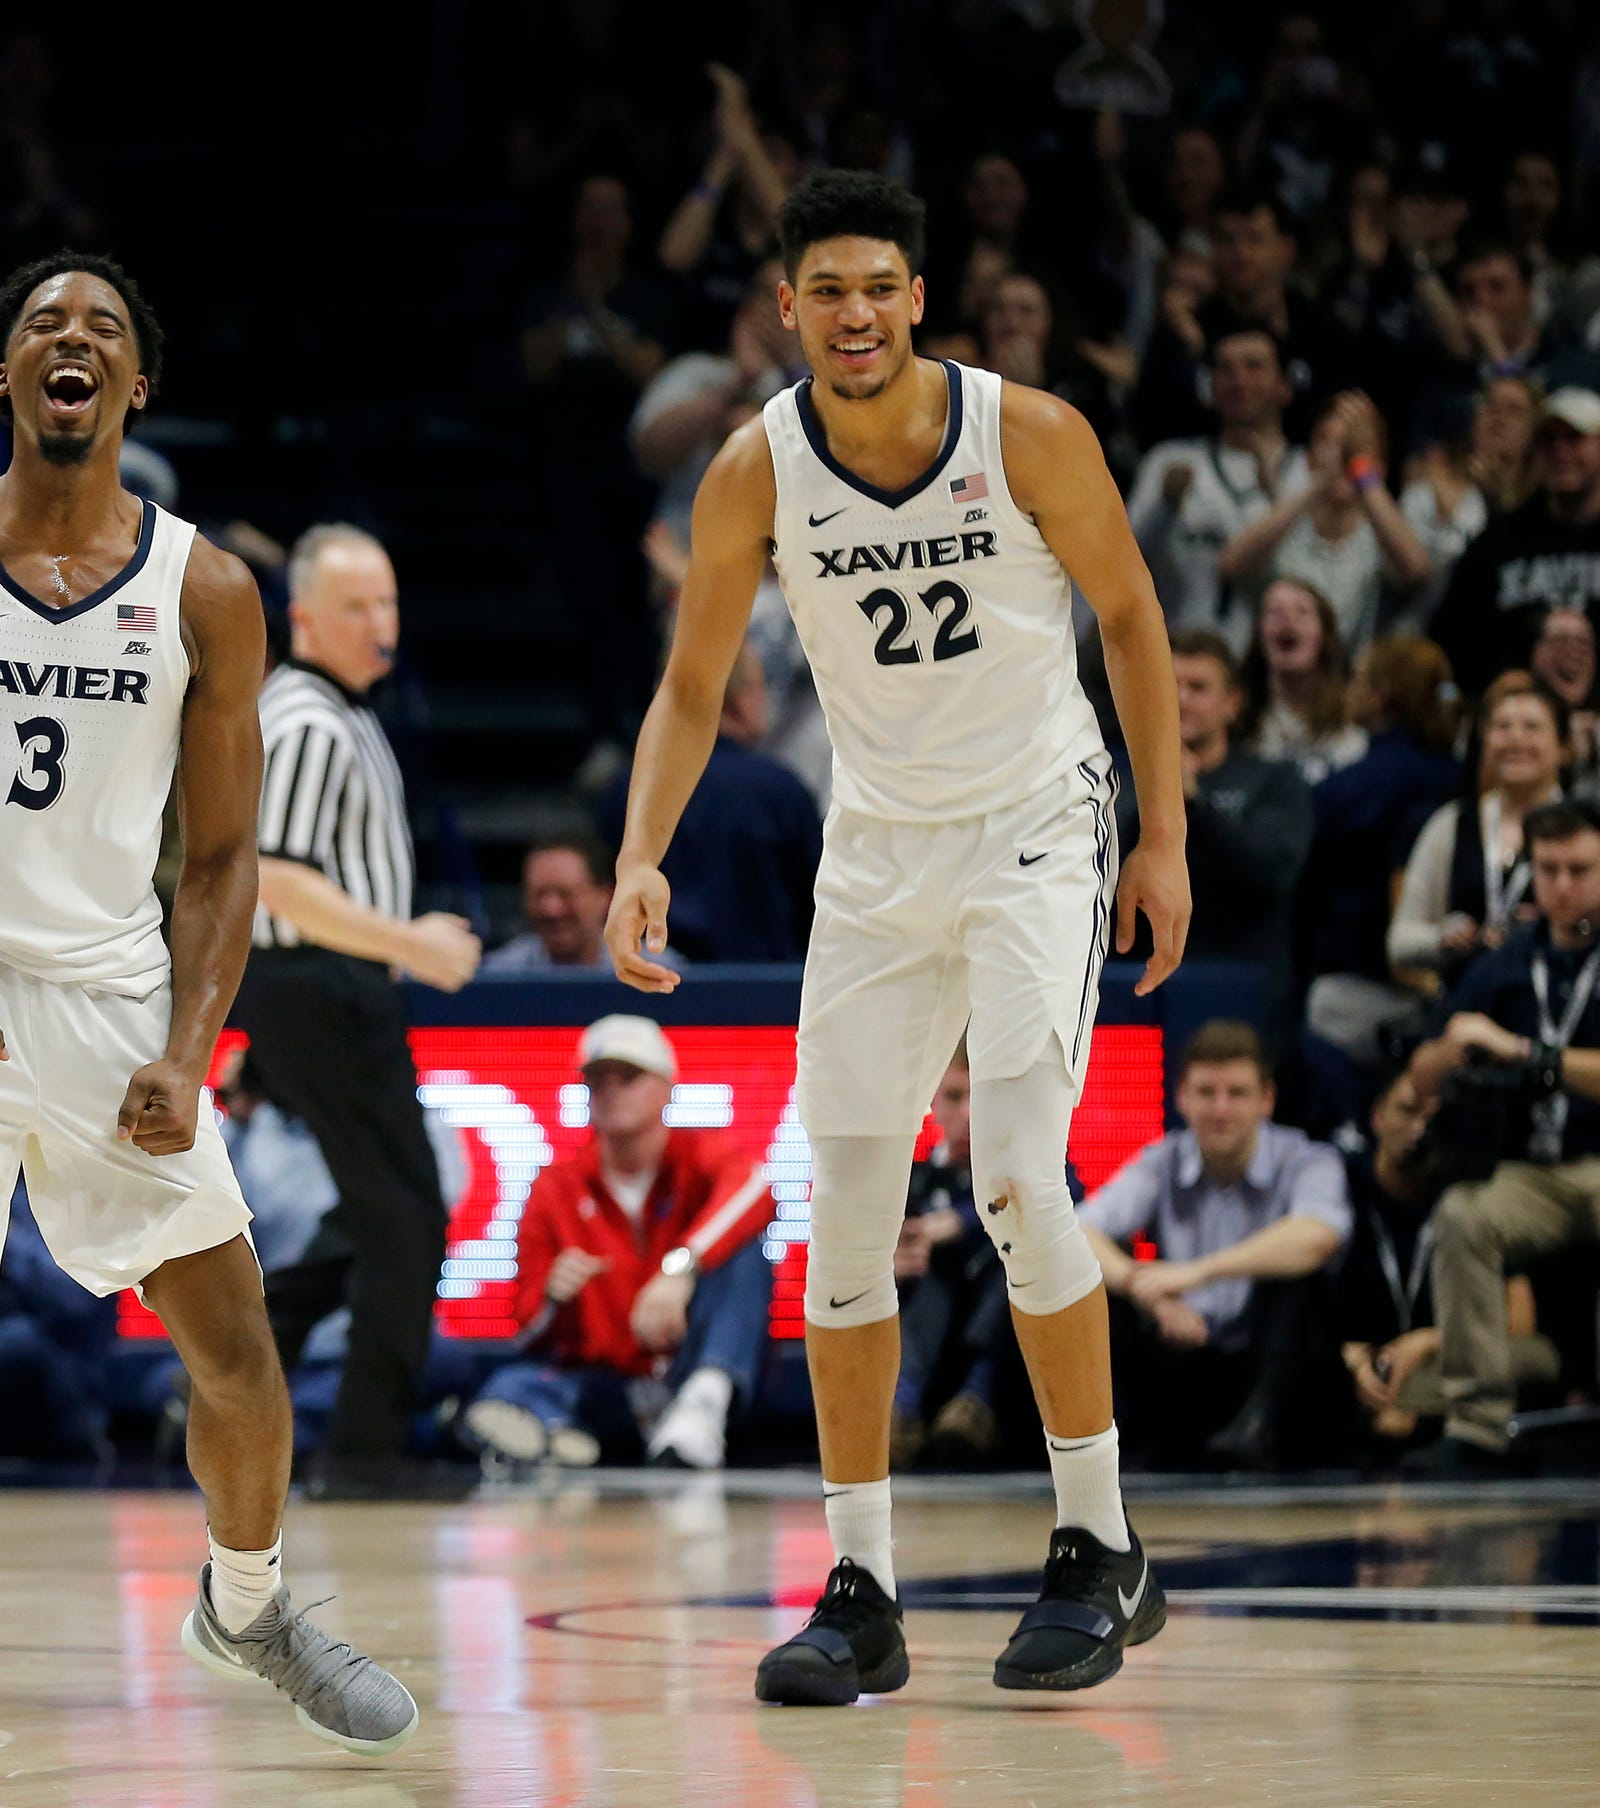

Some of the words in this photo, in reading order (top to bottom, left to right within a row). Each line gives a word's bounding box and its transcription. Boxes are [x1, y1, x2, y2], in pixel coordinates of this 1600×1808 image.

[810, 531, 998, 578] XAVIER
[856, 580, 983, 666] 22
[5, 716, 70, 812] 3
